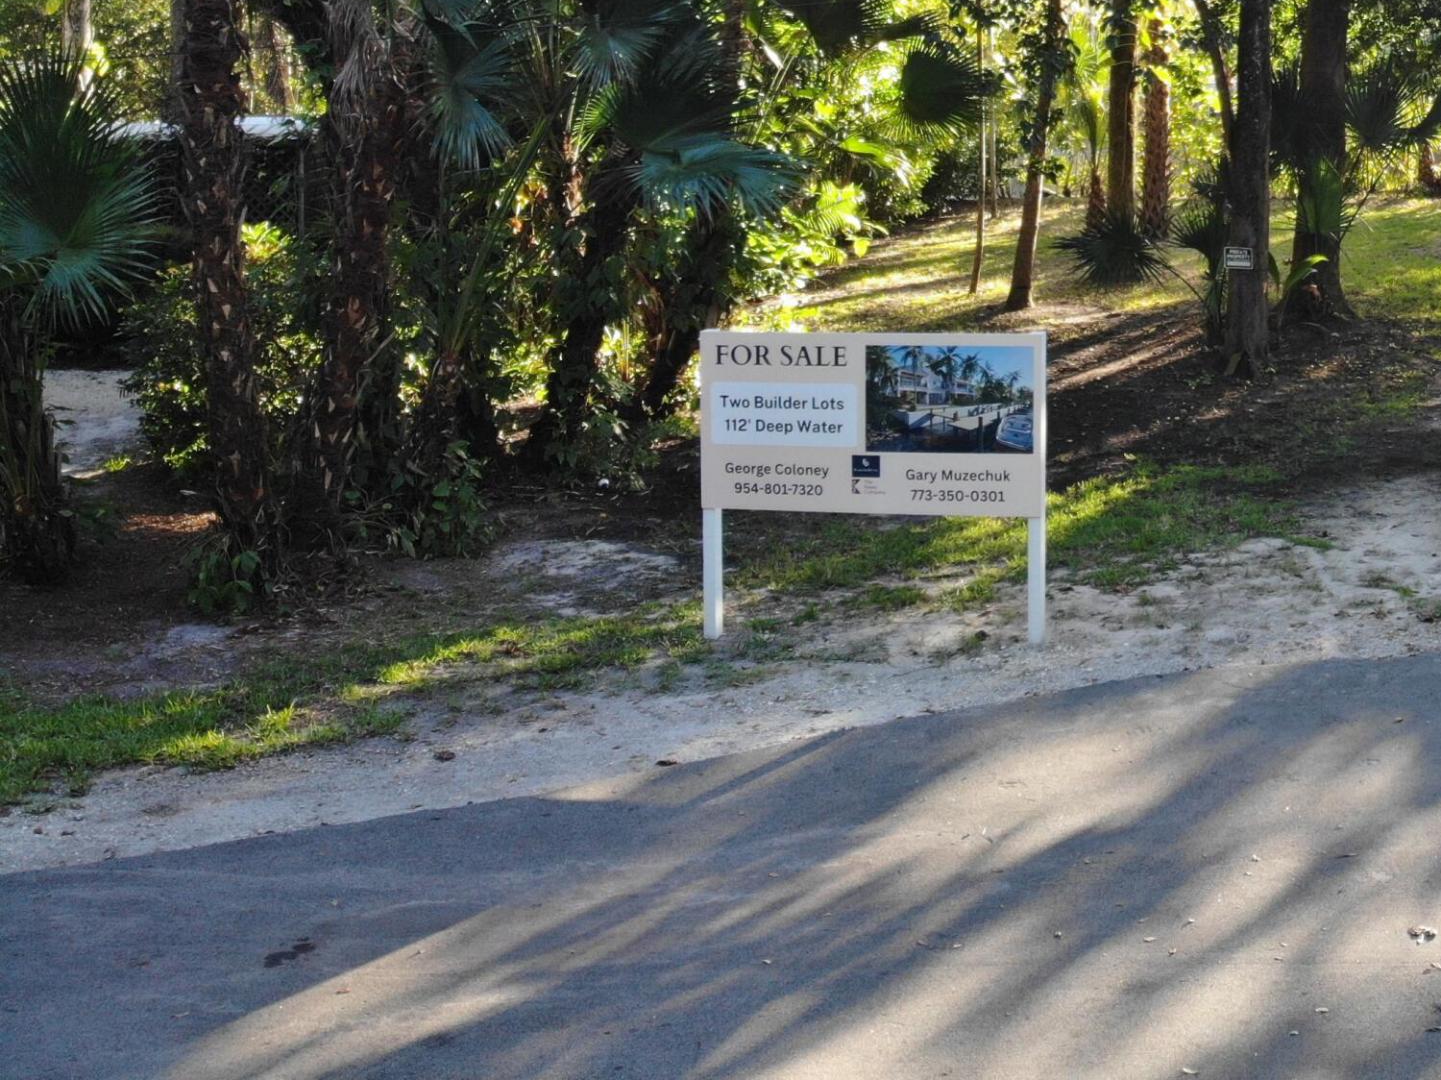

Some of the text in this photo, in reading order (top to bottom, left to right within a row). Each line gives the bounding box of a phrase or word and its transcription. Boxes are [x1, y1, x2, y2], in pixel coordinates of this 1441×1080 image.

[715, 344, 848, 367] FOR SALE
[719, 395, 845, 410] Two Builder Lots
[755, 419, 793, 435] Deep
[797, 420, 843, 433] Water
[725, 462, 829, 479] George Coloney
[905, 469, 1011, 484] Gary Muzechuk
[734, 482, 823, 496] 954-801-7320
[910, 490, 1005, 502] 773-350-0301
